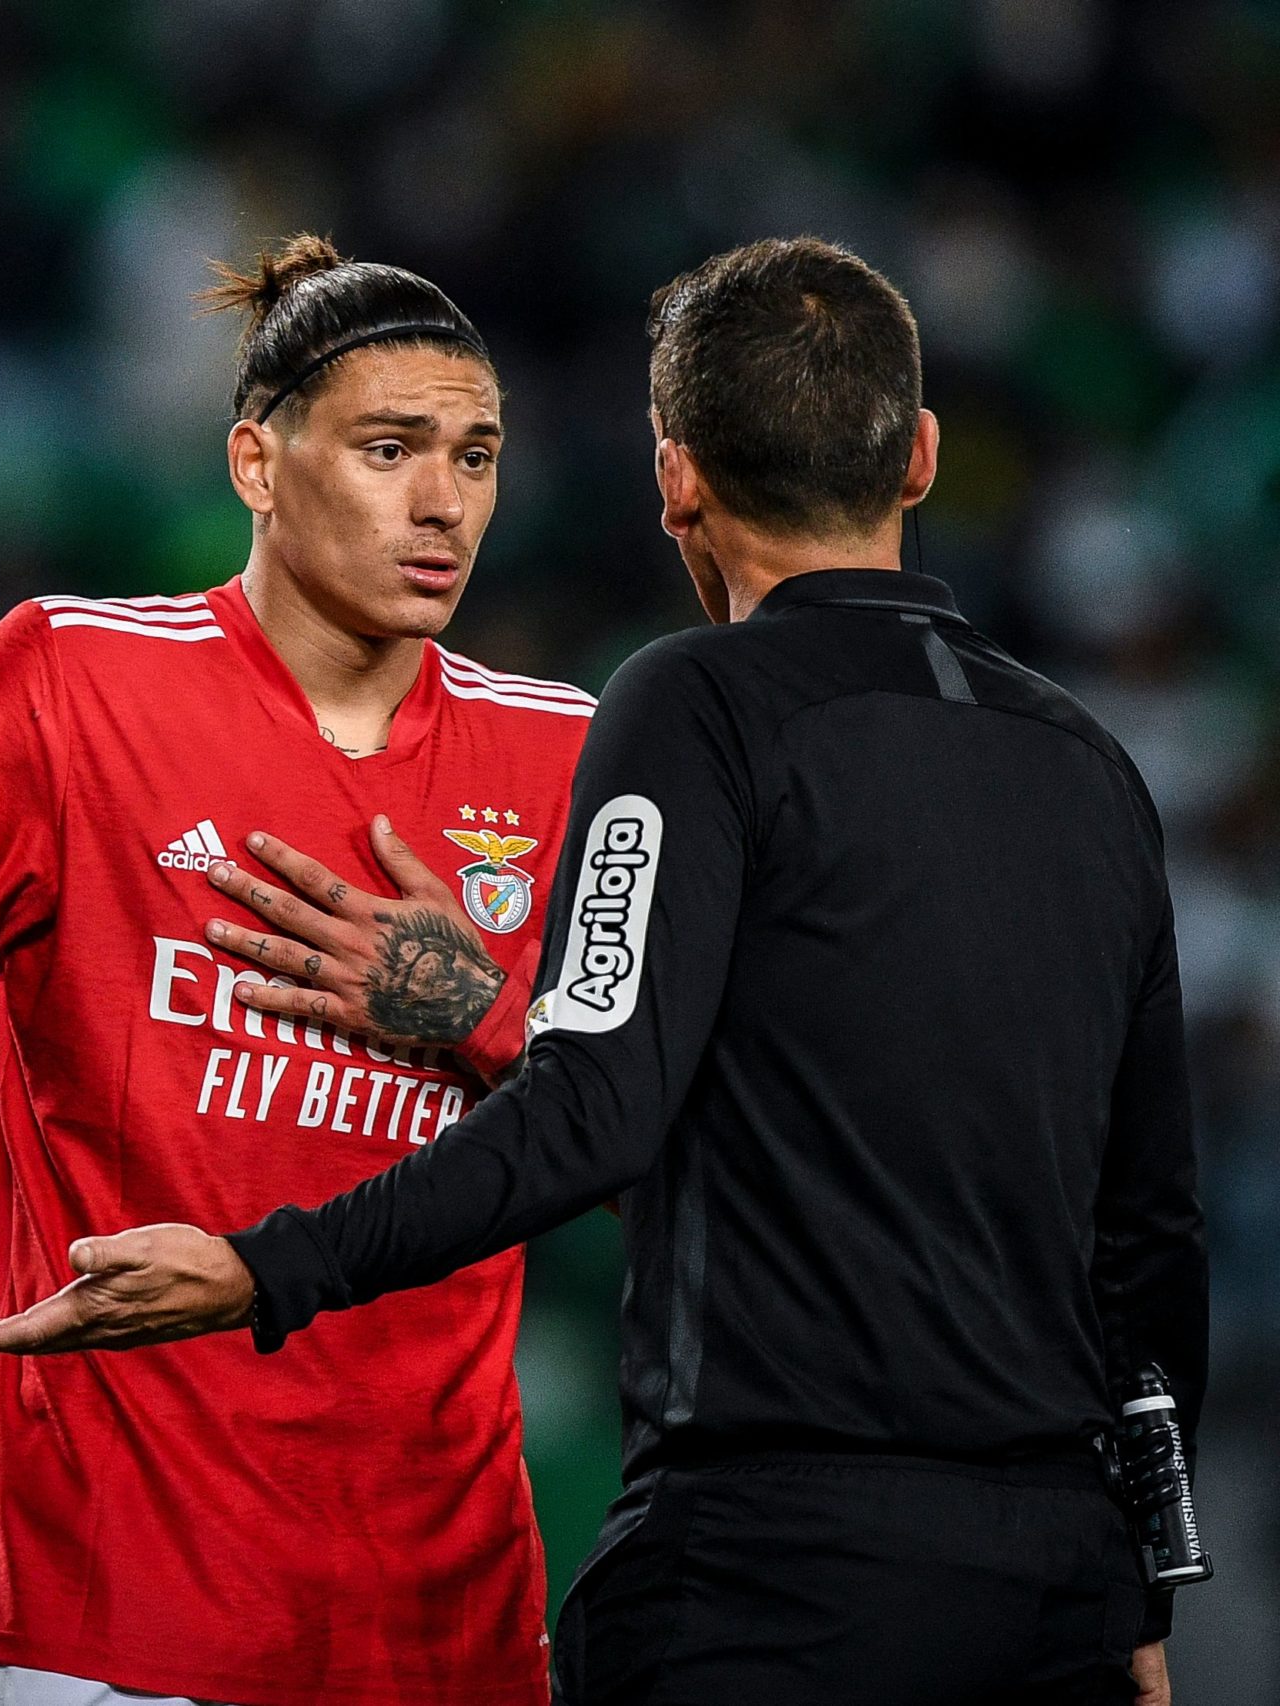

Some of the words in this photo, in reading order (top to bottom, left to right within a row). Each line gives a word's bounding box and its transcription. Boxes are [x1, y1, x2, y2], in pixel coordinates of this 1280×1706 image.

[157, 849, 238, 873] adid
[567, 818, 650, 1012] Agriloja
[196, 1048, 290, 1122] FLY
[296, 1061, 465, 1146] BETTER
[1166, 1420, 1187, 1471] SPRAY
[1180, 1473, 1202, 1560] VANISHING
